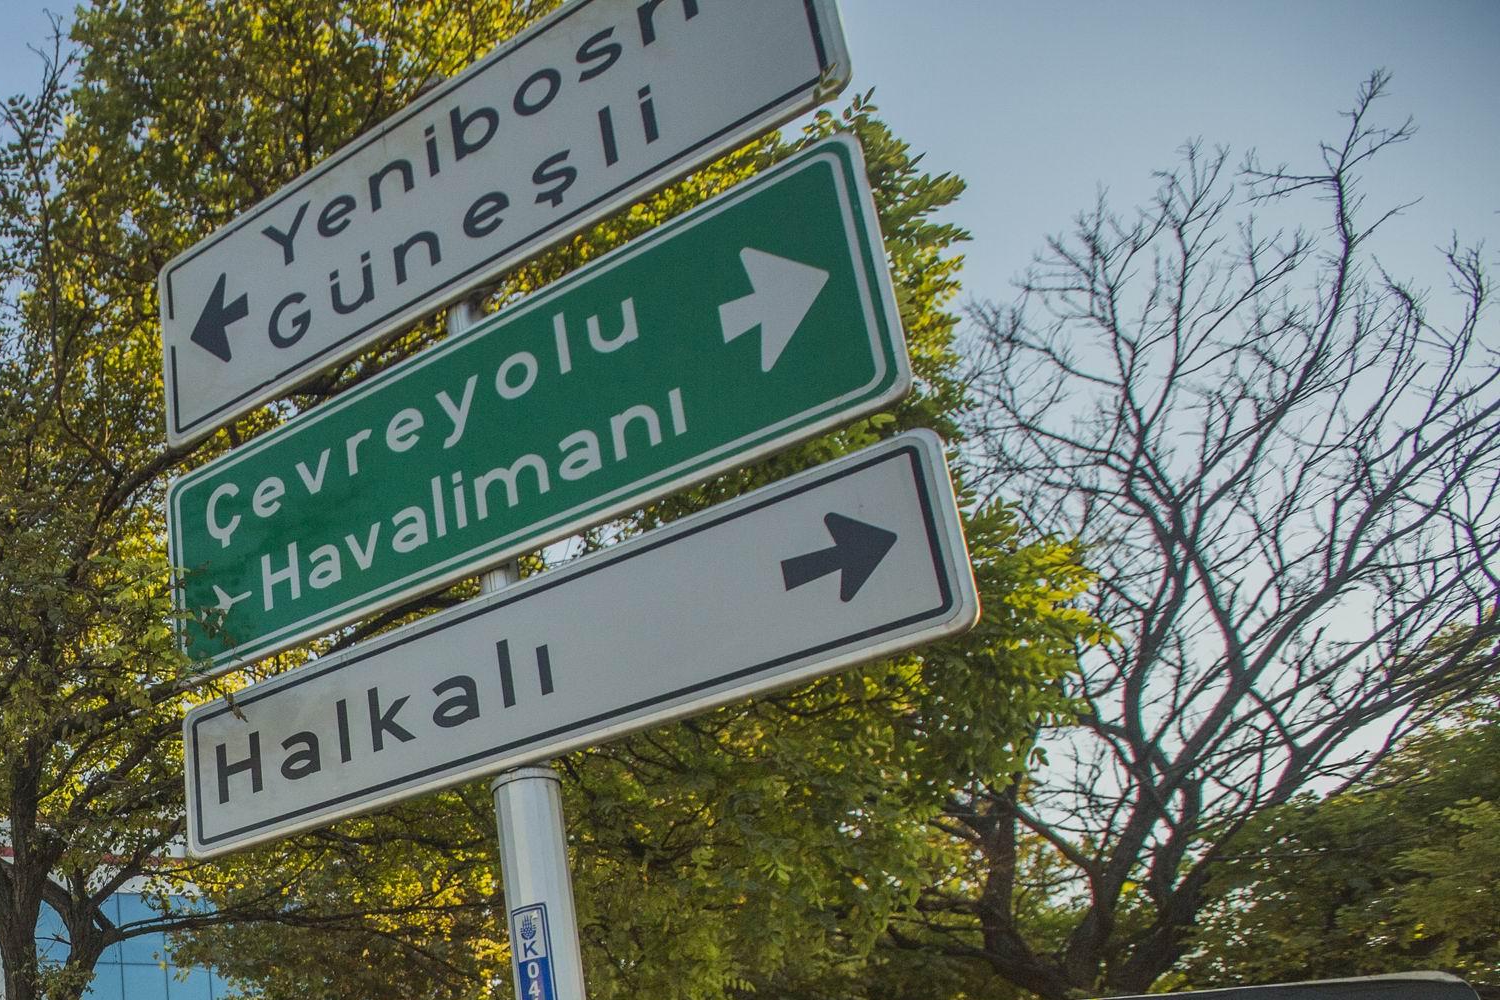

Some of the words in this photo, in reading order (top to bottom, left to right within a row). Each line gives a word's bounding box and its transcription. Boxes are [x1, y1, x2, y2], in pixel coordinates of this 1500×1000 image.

[269, 84, 660, 349] Güneşli
[206, 297, 639, 549] Çevreyolu
[260, 387, 687, 612] Havalimanı
[215, 638, 554, 805] Halkalı
